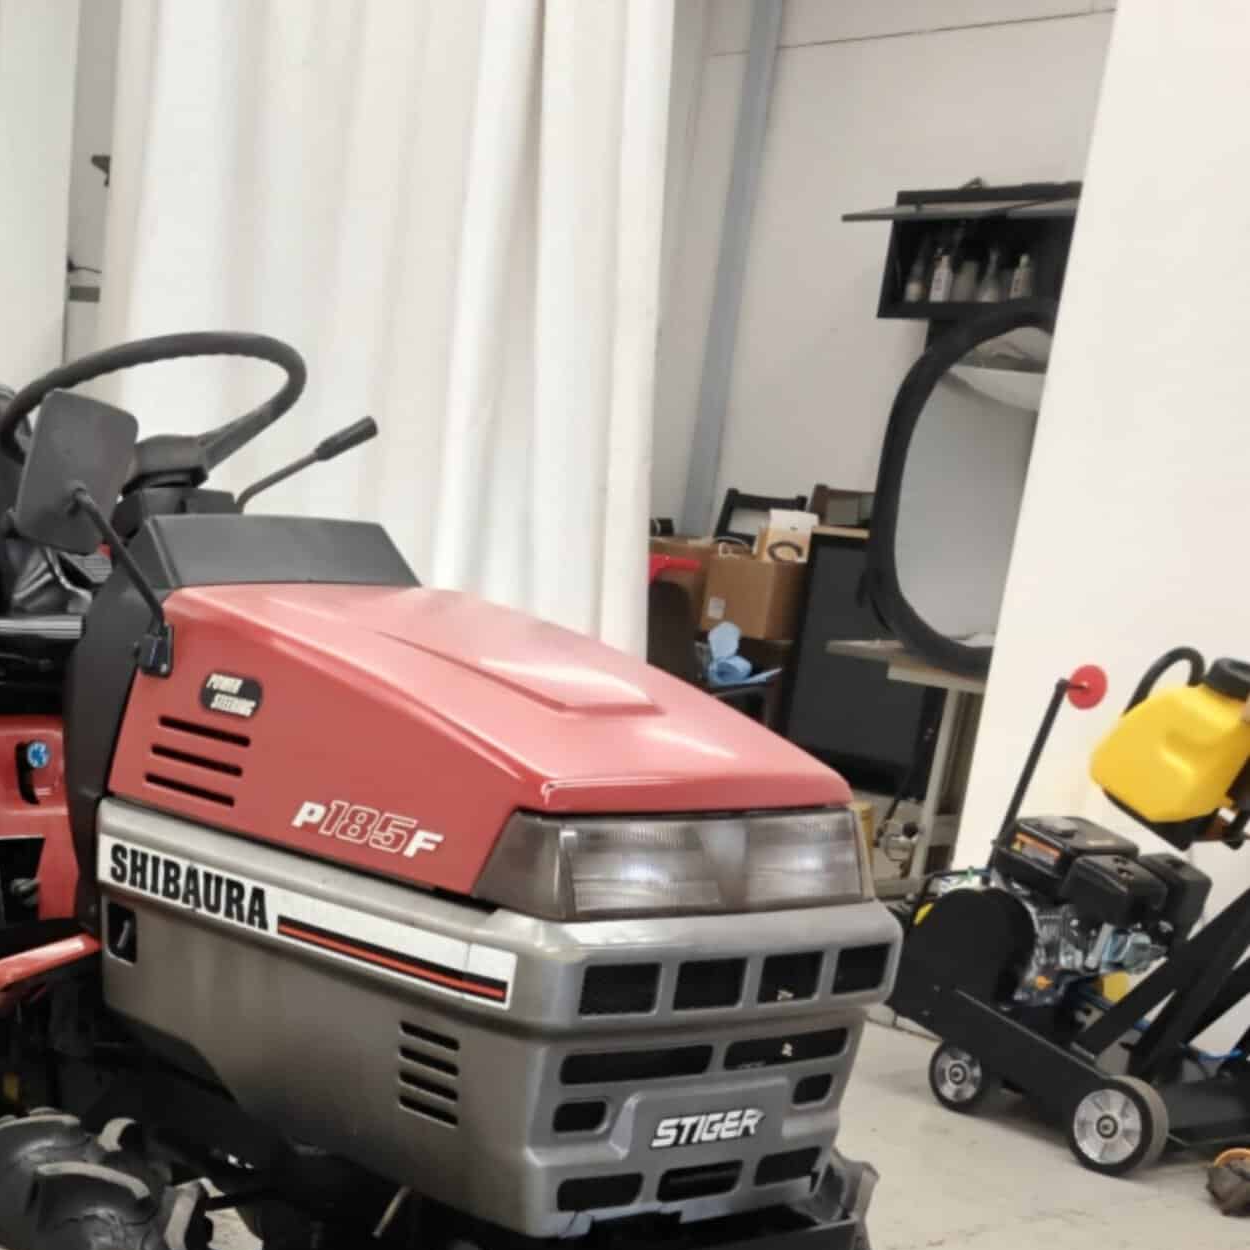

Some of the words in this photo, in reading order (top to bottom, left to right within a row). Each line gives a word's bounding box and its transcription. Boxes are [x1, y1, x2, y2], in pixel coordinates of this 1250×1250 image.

[291, 799, 445, 859] P185F
[110, 843, 269, 931] SHIBAURA
[650, 1107, 766, 1149] STIGER
